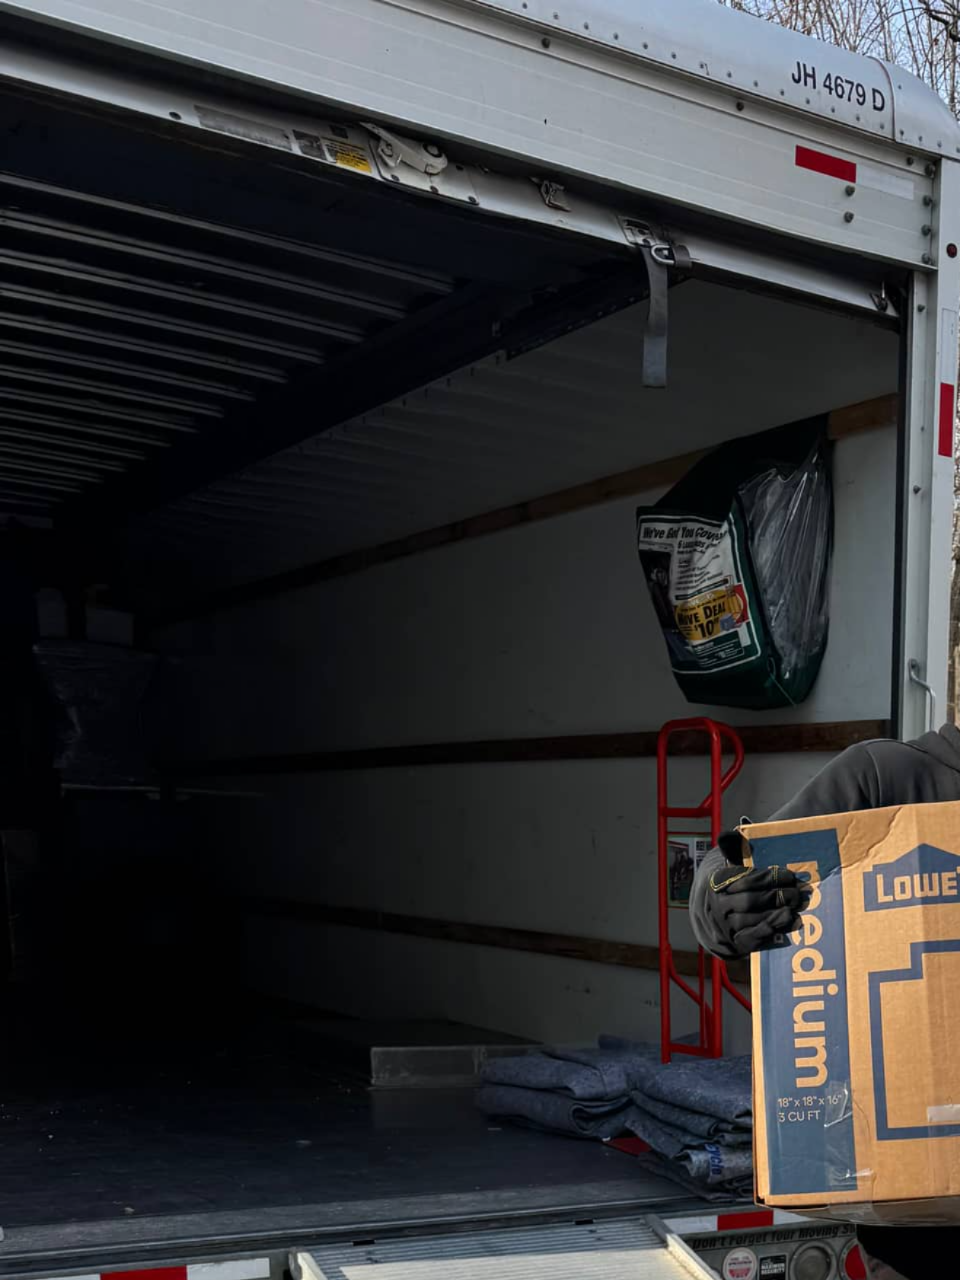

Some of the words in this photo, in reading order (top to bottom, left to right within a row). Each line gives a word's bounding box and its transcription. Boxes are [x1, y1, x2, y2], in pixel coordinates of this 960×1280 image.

[791, 61, 817, 90] JH
[822, 72, 867, 106] 4679
[871, 87, 886, 112] D
[778, 1111, 786, 1123] 3
[787, 1110, 805, 1122] CU
[806, 1109, 822, 1121] FT
[798, 1225, 841, 1240] Moving
